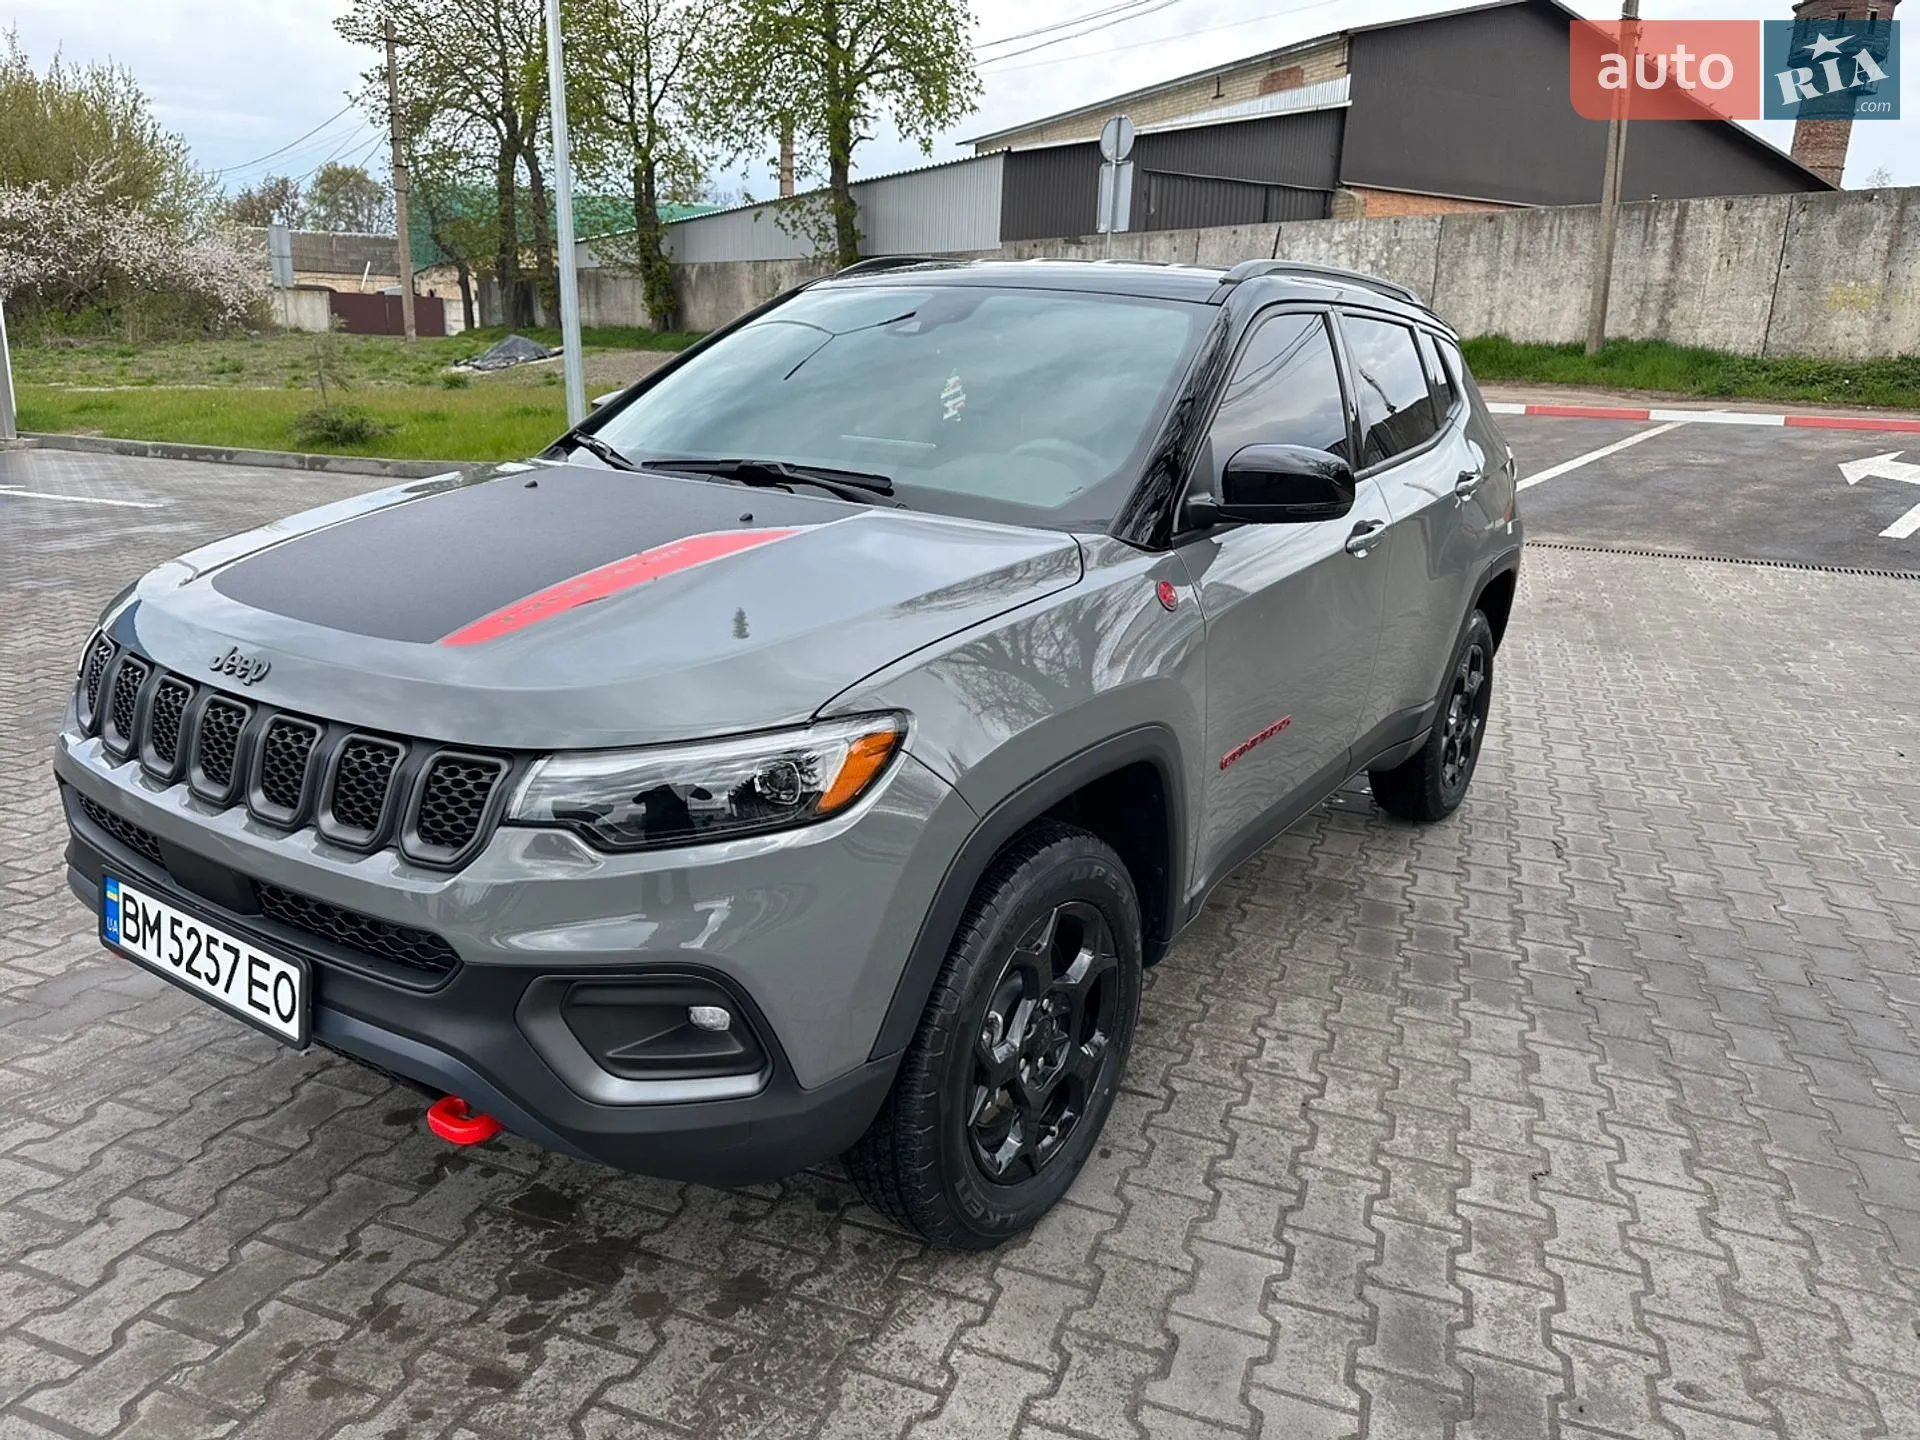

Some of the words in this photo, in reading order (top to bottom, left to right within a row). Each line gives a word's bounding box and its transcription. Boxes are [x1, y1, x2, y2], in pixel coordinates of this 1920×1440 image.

[209, 646, 271, 686] Jeep
[122, 892, 162, 958] BM
[168, 916, 241, 993] 5257
[248, 954, 296, 1023] EO
